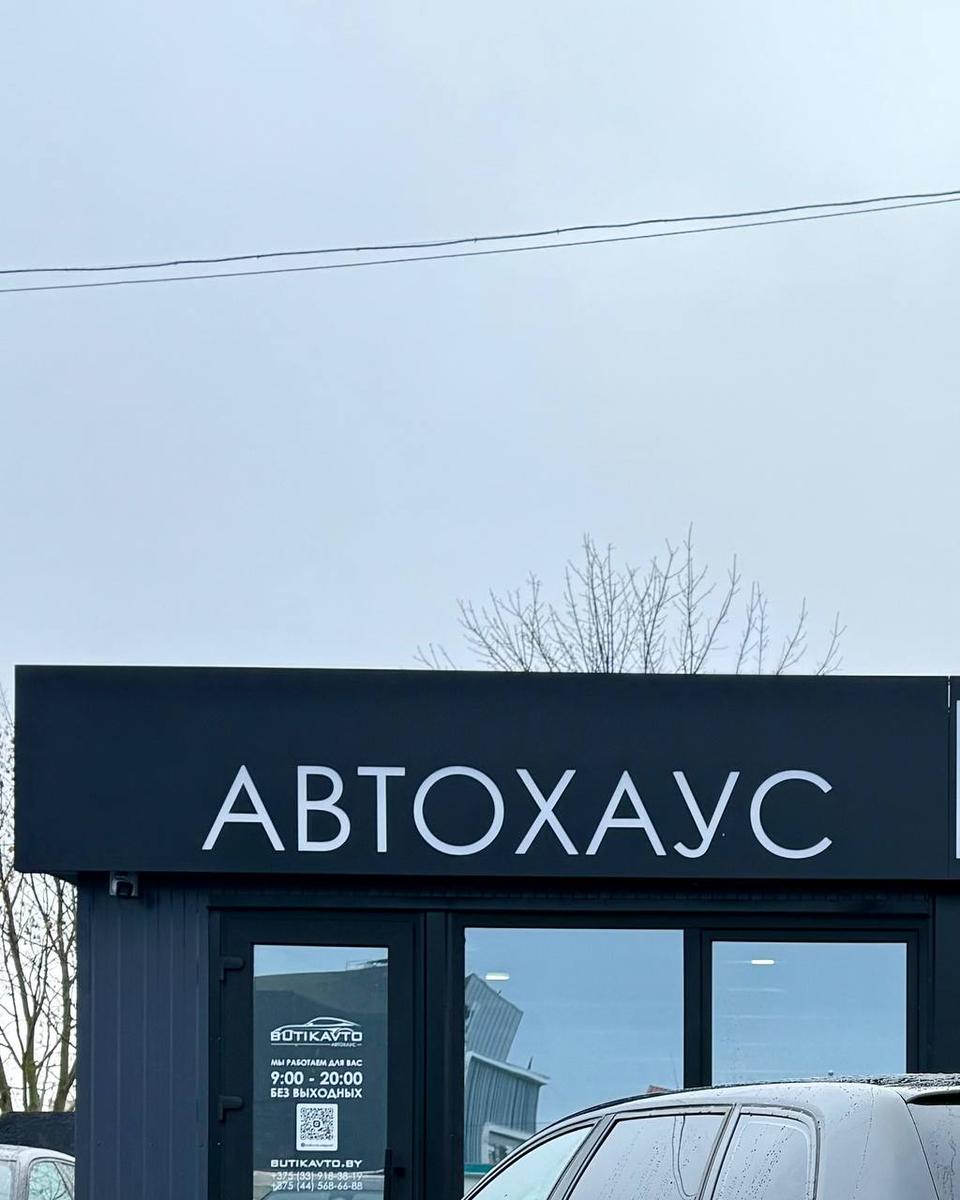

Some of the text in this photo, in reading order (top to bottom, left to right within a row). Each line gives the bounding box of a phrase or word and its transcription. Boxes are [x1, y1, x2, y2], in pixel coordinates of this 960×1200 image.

[202, 764, 833, 860] АВТОХАУС
[270, 1030, 363, 1042] BUTIKAVTO
[270, 1058, 363, 1068] МЫ РАБОТАЕМ ДЛЯ ВАС
[270, 1071, 304, 1086] 9:00
[320, 1071, 363, 1086] 20:00
[270, 1087, 363, 1100] БЕЗ ВЫХОДНЫХ
[270, 1159, 363, 1168] BUTIKAVTO.BY
[296, 1181, 315, 1192] (44)
[316, 1181, 363, 1190] 568-66-88
